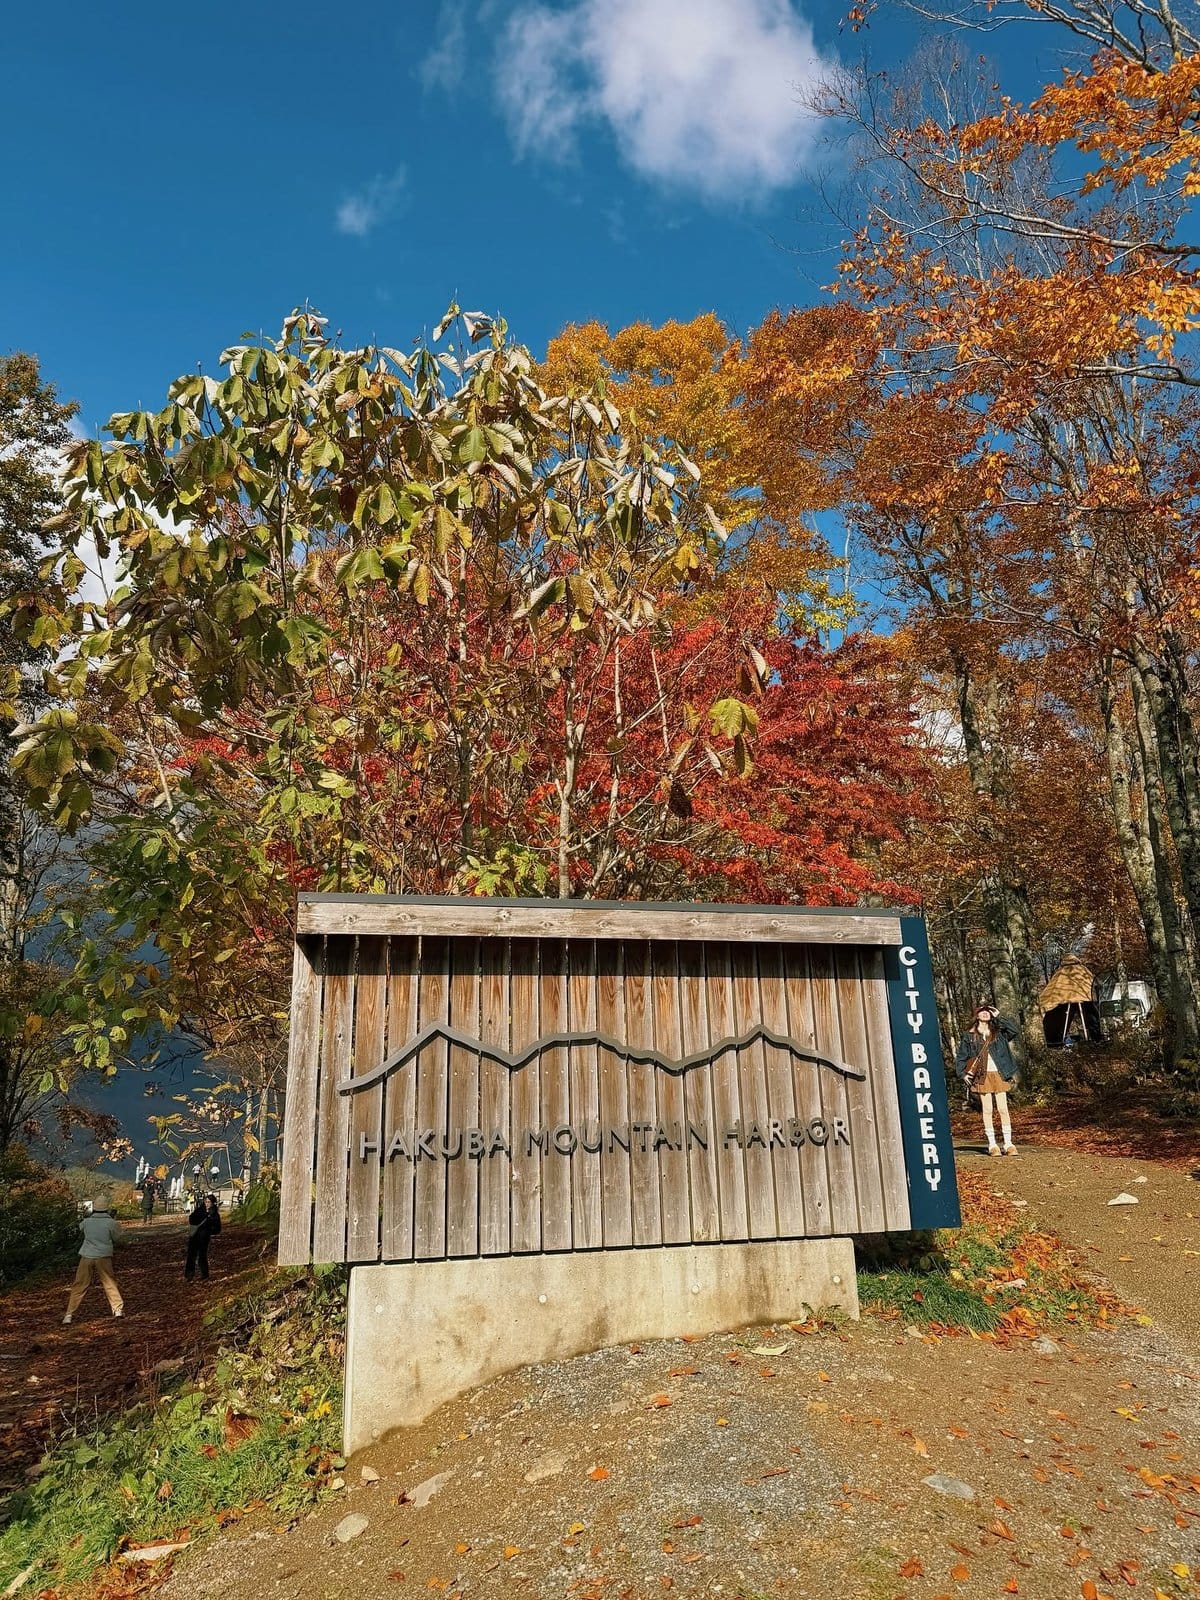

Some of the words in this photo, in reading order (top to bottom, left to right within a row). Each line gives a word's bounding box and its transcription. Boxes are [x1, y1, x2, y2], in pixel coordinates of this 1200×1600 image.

[899, 945, 924, 1034] CITY
[359, 1127, 511, 1160] HAKUBA
[525, 1119, 709, 1154] MOUNTAIN
[722, 1116, 850, 1150] HARBOR
[911, 1043, 941, 1191] BAKERY
